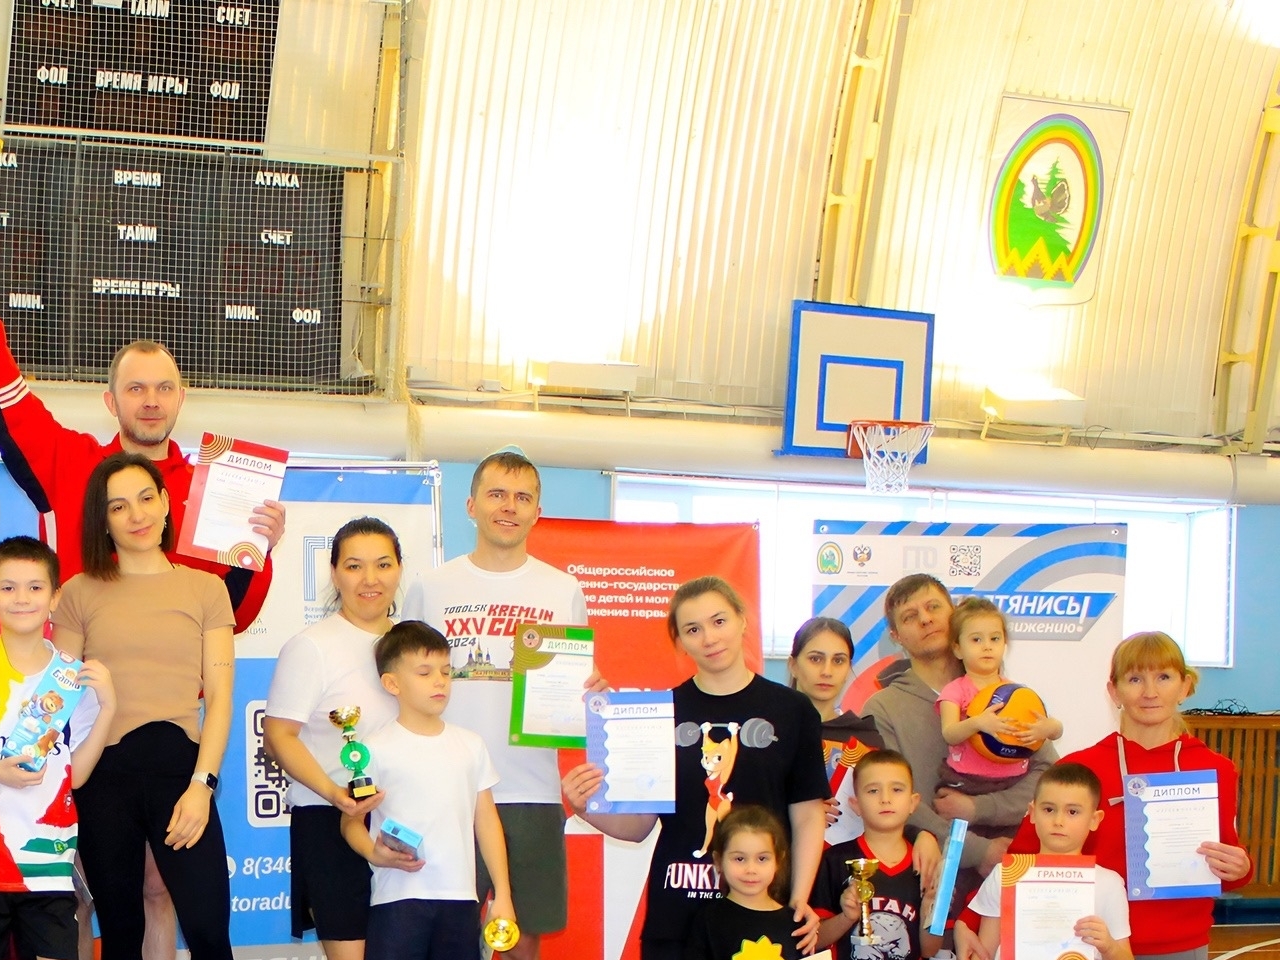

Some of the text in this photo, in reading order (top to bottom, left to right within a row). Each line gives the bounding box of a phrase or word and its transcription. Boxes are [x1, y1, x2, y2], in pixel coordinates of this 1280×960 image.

[216, 6, 251, 26] СЧЕТ
[36, 66, 68, 86] ФОЛ
[96, 71, 189, 96] ВРЕМЯ ИГРЫ
[210, 81, 240, 100] ФОЛ
[114, 169, 162, 188] ВРЕМЯ
[255, 170, 300, 189] АТАКА
[117, 223, 158, 242] ТАЙМ
[260, 229, 293, 246] СЧЕТ
[92, 278, 181, 298] ВРЕМЯ ИГРЫ
[9, 292, 44, 311] МИН.
[225, 303, 260, 321] МИН.
[292, 307, 320, 325] ФОЛ
[227, 454, 272, 471] ДИПЛОМ
[567, 563, 675, 577] Общероссийское
[598, 594, 633, 604] детей
[444, 604, 554, 621] TOBOLSK KREMLIN
[445, 617, 537, 637] XXV CU
[447, 637, 477, 648] 2024
[547, 640, 588, 652] ДИПЛОМ
[613, 706, 658, 716] ДИПЛОМ
[1153, 786, 1201, 798] ДИПЛОМ
[242, 856, 291, 879] 8(346
[1037, 870, 1084, 879] ГРАМОТА
[231, 892, 291, 912] toradu
[687, 891, 697, 899] IN
[699, 891, 713, 899] THE
